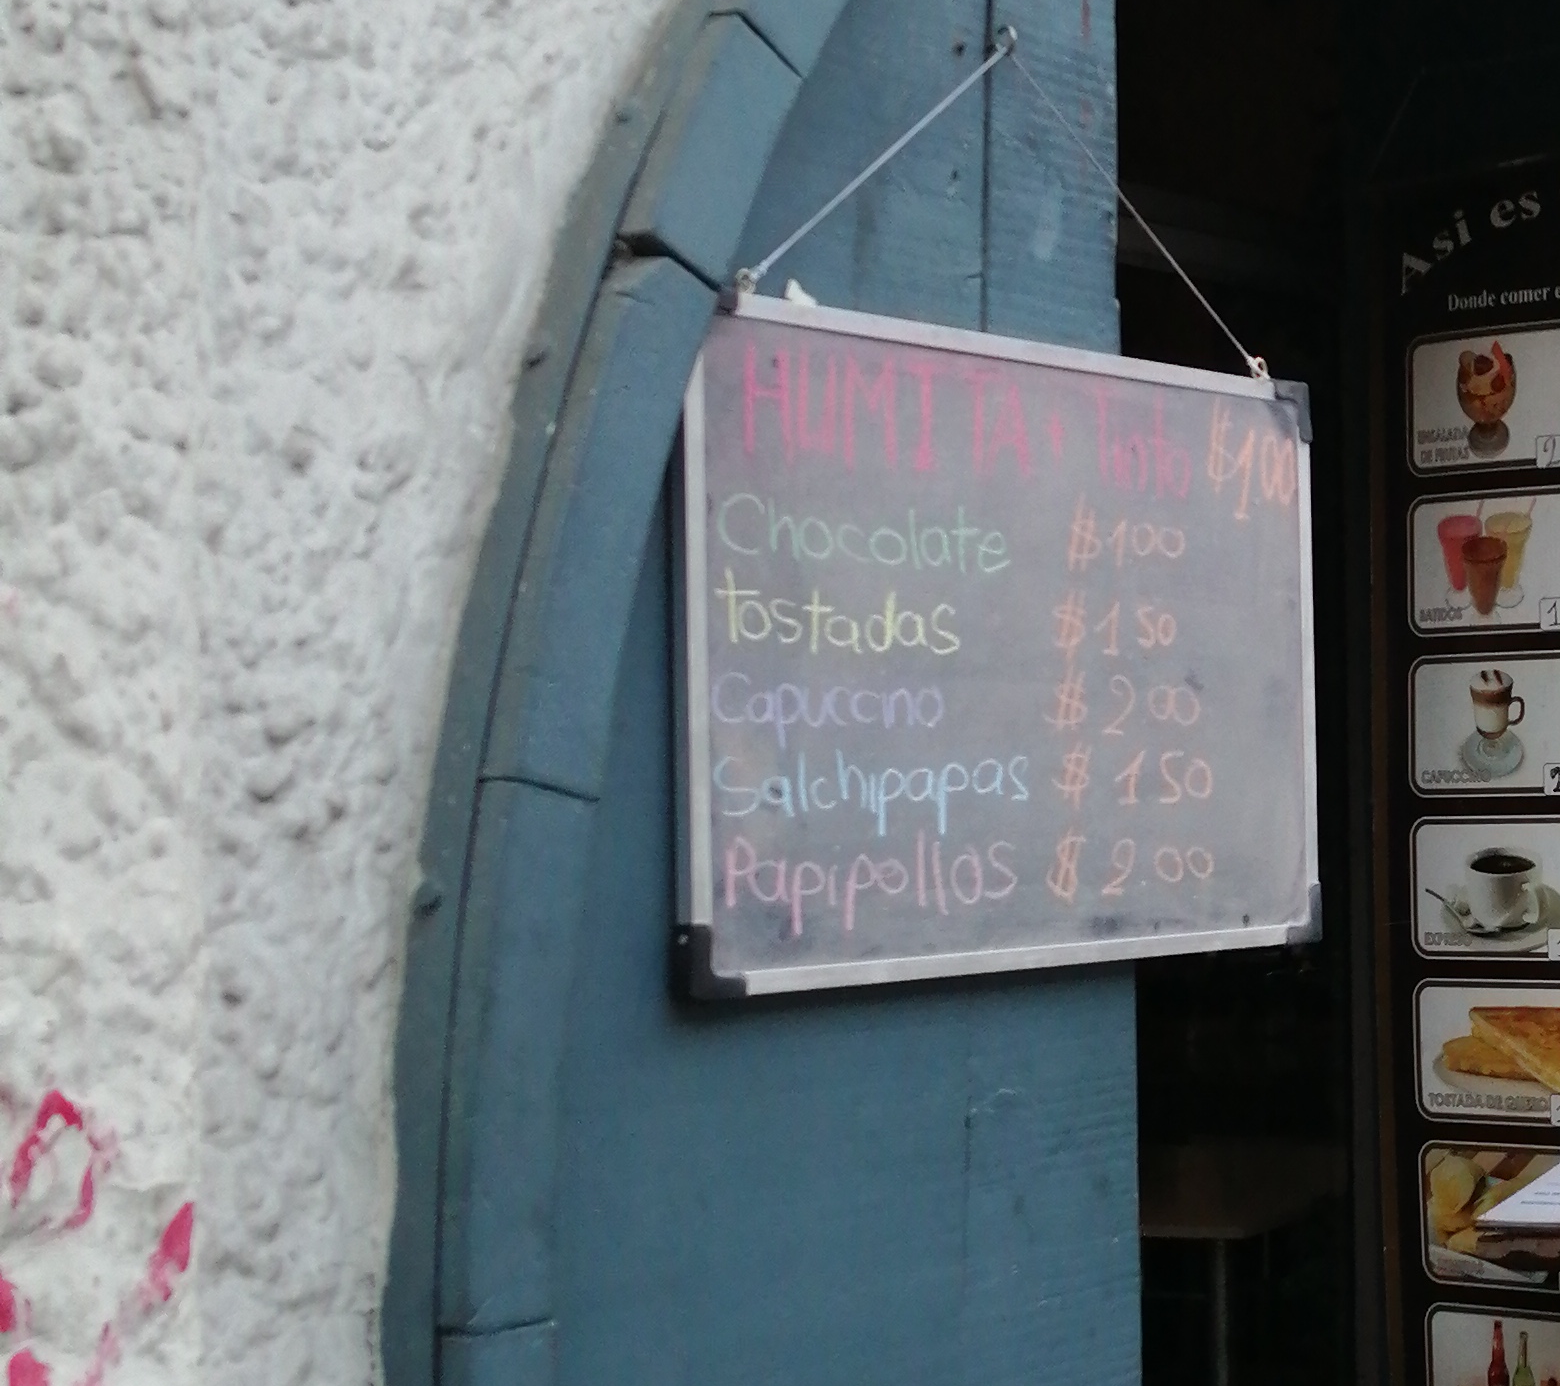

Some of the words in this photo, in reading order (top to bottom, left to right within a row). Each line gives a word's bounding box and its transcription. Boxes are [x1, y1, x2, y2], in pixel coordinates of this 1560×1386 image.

[1401, 210, 1472, 295] Asi
[1489, 191, 1542, 229] es
[1448, 291, 1497, 311] Donde
[1500, 286, 1550, 306] comer
[743, 338, 1033, 481] HUMITA
[717, 492, 1012, 573] Chocolate
[713, 748, 1029, 837] Salchipapas
[1427, 1092, 1485, 1109] TOSTADA
[1486, 1095, 1501, 1110] DE
[1505, 1095, 1550, 1112] QUESO
